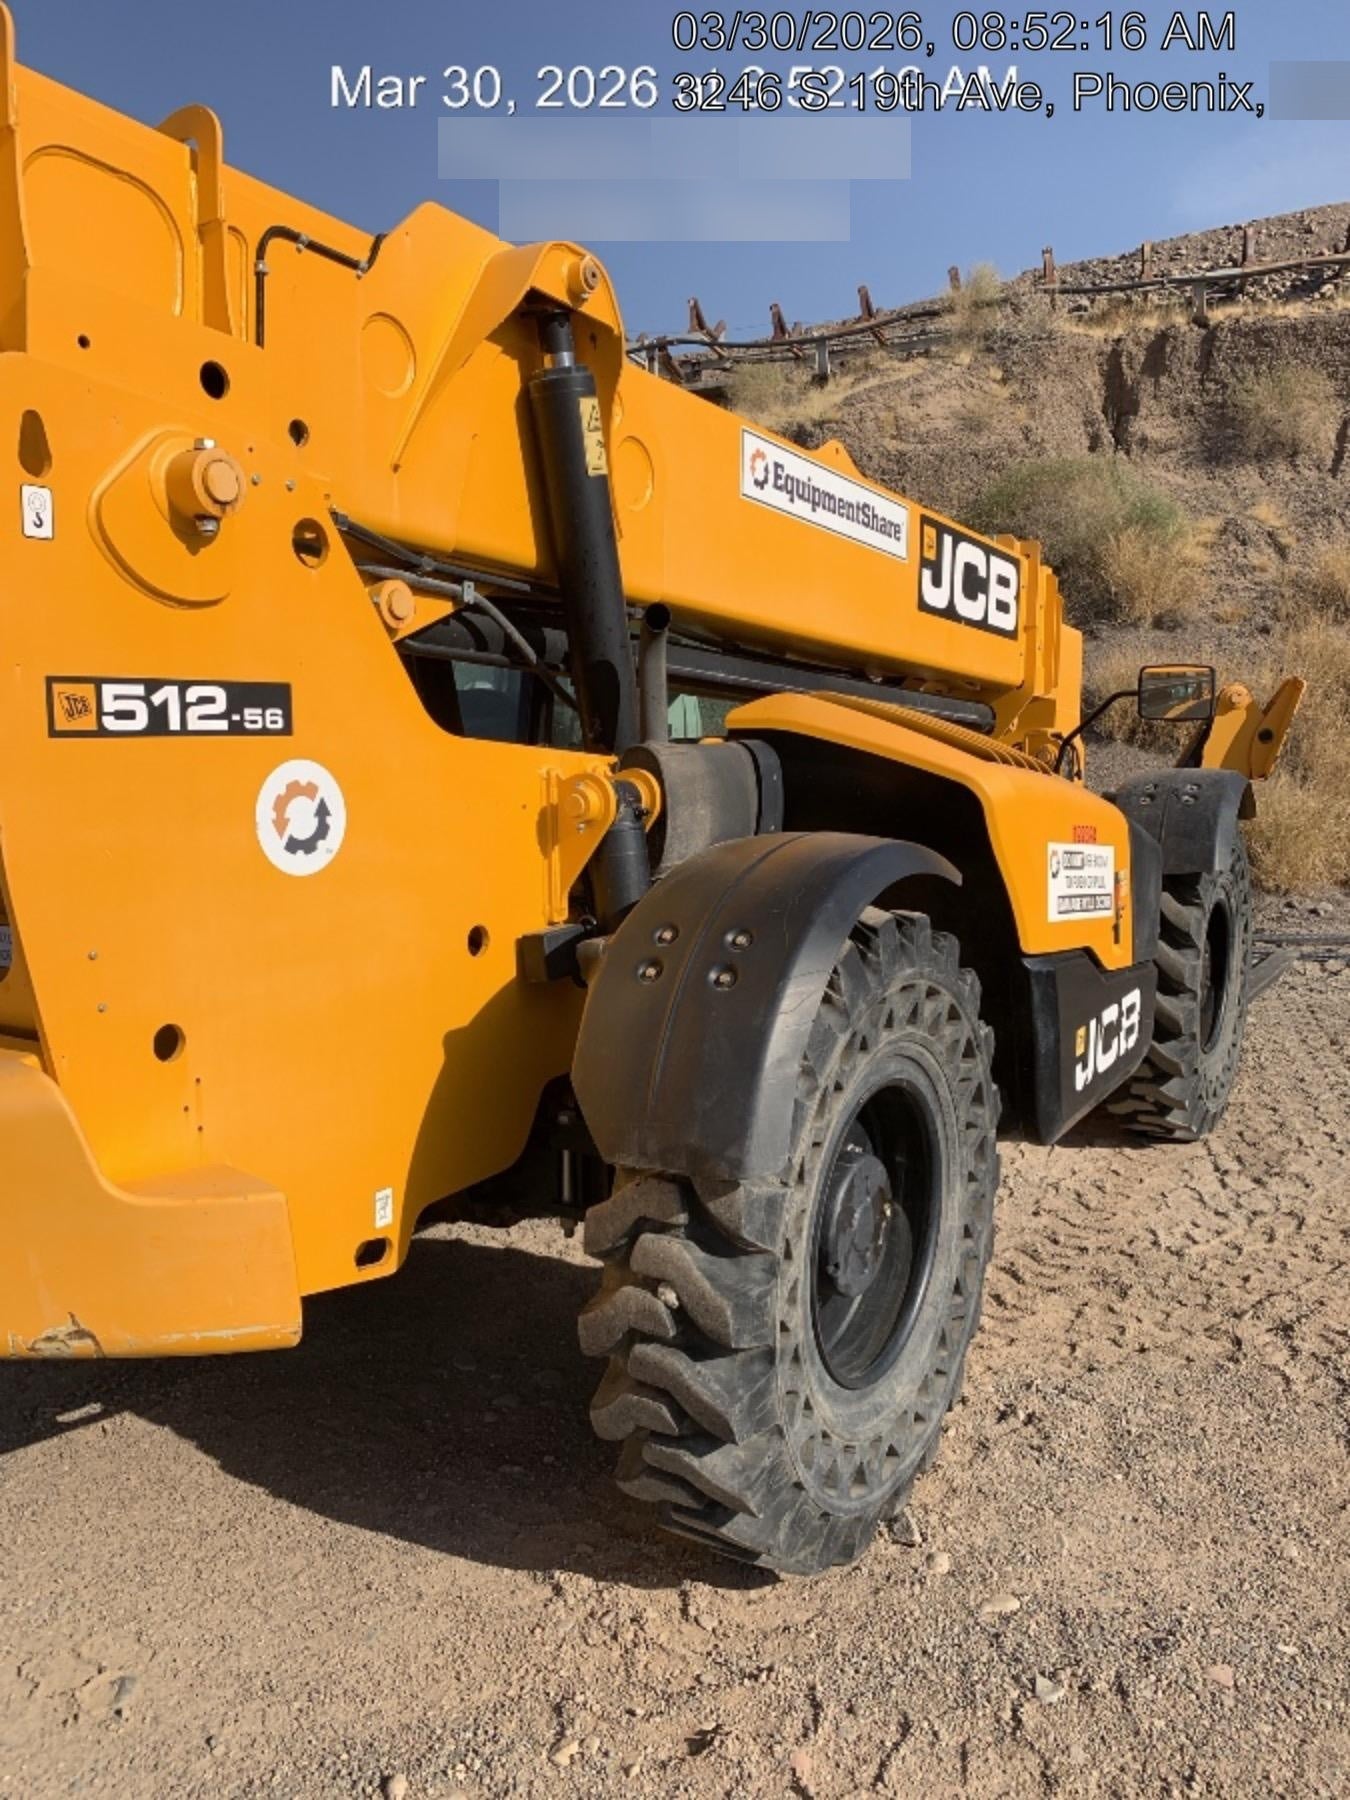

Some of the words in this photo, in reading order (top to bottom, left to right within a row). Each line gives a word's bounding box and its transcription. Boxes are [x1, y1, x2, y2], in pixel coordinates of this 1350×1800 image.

[772, 461, 902, 542] EquipmentShare
[921, 533, 1018, 631] JCB
[101, 683, 284, 731] 512-56
[1075, 987, 1141, 1091] JCB
